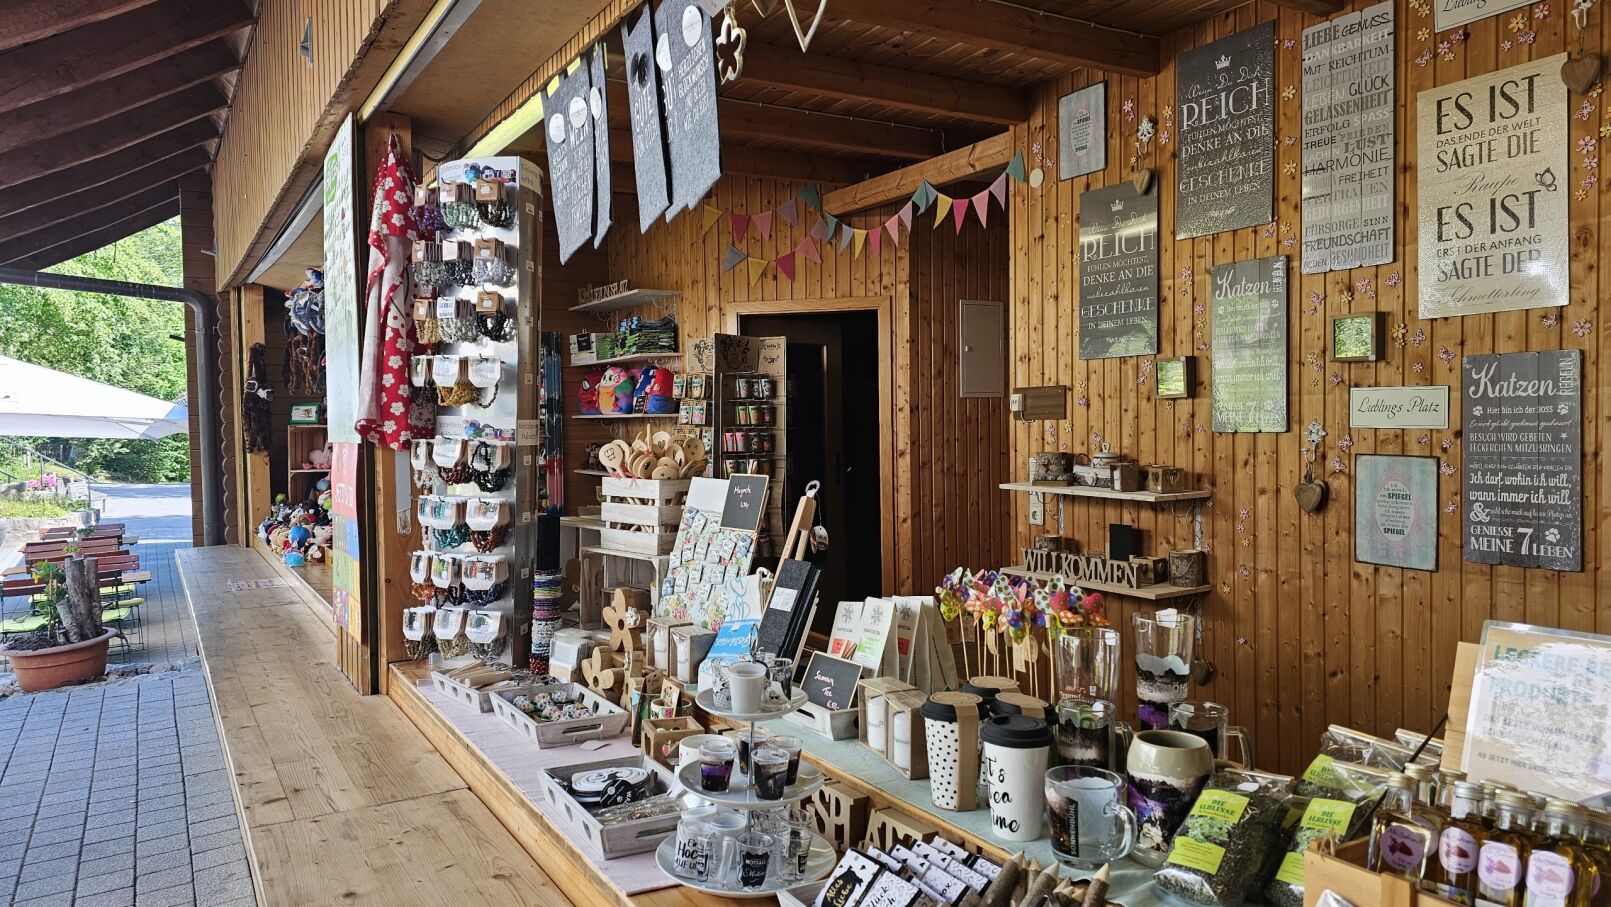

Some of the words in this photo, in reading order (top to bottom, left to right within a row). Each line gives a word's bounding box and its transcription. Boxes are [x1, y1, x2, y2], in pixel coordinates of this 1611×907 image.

[1304, 24, 1340, 51] LIEBE
[1341, 12, 1391, 37] GENUSS
[1304, 28, 1390, 64] DANKBARKEIT
[1304, 63, 1326, 77] MUT
[1328, 43, 1389, 71] REICHTUM
[1305, 58, 1389, 94] LEICHTIGKEIT
[1181, 77, 1271, 131] REICH
[1305, 87, 1345, 110] LEBEN
[1349, 73, 1389, 97] GLÜCK
[1436, 92, 1474, 135] ES
[1489, 73, 1541, 122] IST
[1304, 90, 1390, 125] GELASSENHEIT
[1304, 119, 1351, 139] ERFOLG
[1353, 107, 1390, 127] SPASS
[1436, 137, 1457, 149] DAS
[1459, 129, 1487, 143] ENDE
[1488, 124, 1509, 137] DER
[1511, 117, 1542, 131] WELT
[1182, 137, 1222, 158] DENKE
[1225, 131, 1242, 145] AN
[1247, 123, 1269, 140] DIE
[1304, 135, 1337, 150] TREUE
[1344, 133, 1390, 154] LUST
[1436, 138, 1498, 173] SAGTE
[1507, 128, 1541, 159] DIE
[1305, 146, 1389, 177] HARMONIE
[1339, 165, 1390, 185] FREIHEIT
[1180, 159, 1269, 193] GESCHENKE
[1305, 193, 1390, 221] GEBORGENHEIT
[1437, 202, 1474, 243] ES
[1489, 190, 1542, 235] IST
[1304, 227, 1391, 252] FREUNDSCHAFT
[1305, 217, 1360, 237] FÜRSORGE
[1364, 215, 1388, 227] SINN
[1081, 225, 1154, 263] REICH
[1331, 242, 1390, 266] GESUNDHEIT
[1465, 242, 1487, 254] DER
[1489, 234, 1542, 251] ANFANG
[1083, 271, 1116, 287] DENKE
[1118, 268, 1133, 281] AN
[1136, 264, 1154, 278] DIE
[1437, 255, 1494, 283] SAGTE
[1215, 269, 1271, 300] Katzen
[1081, 296, 1155, 319] GESCHENKE
[1088, 322, 1096, 330] IN
[1097, 318, 1124, 329] DEINEM
[1125, 315, 1148, 326] LEBEN
[1468, 361, 1557, 398] Katzen
[1558, 358, 1576, 395] REGELN
[1357, 396, 1403, 420] Lieblings
[1406, 395, 1440, 414] Platz
[1487, 406, 1500, 414] Hier
[1501, 406, 1513, 414] bin
[1514, 405, 1524, 414] ich
[1525, 405, 1536, 413] der
[1470, 432, 1496, 442] BESUCH
[1498, 432, 1518, 442] WIRD
[1520, 432, 1552, 442] GEBETEN
[1470, 443, 1513, 452] LECKERCHEN
[1515, 443, 1572, 453] MITZUBRINGEN
[1504, 472, 1532, 486] wohin
[1533, 472, 1547, 487] ich
[1548, 473, 1572, 489] will,
[1387, 492, 1411, 501] SPIEGEL
[1469, 490, 1496, 501] wann
[1497, 489, 1529, 503] immer
[1530, 488, 1547, 503] ich
[1548, 490, 1571, 505] will
[1469, 502, 1491, 523] &
[1383, 527, 1406, 536] SPIEGEL
[1470, 525, 1514, 537] GENIESSE
[1470, 537, 1514, 554] MEINE
[1517, 527, 1534, 555] 7
[1532, 543, 1574, 559] LEBEN
[1022, 547, 1139, 590] WILLKOMMEN
[1068, 803, 1077, 856] SONNENBÜHL
[825, 878, 844, 901] Alles
